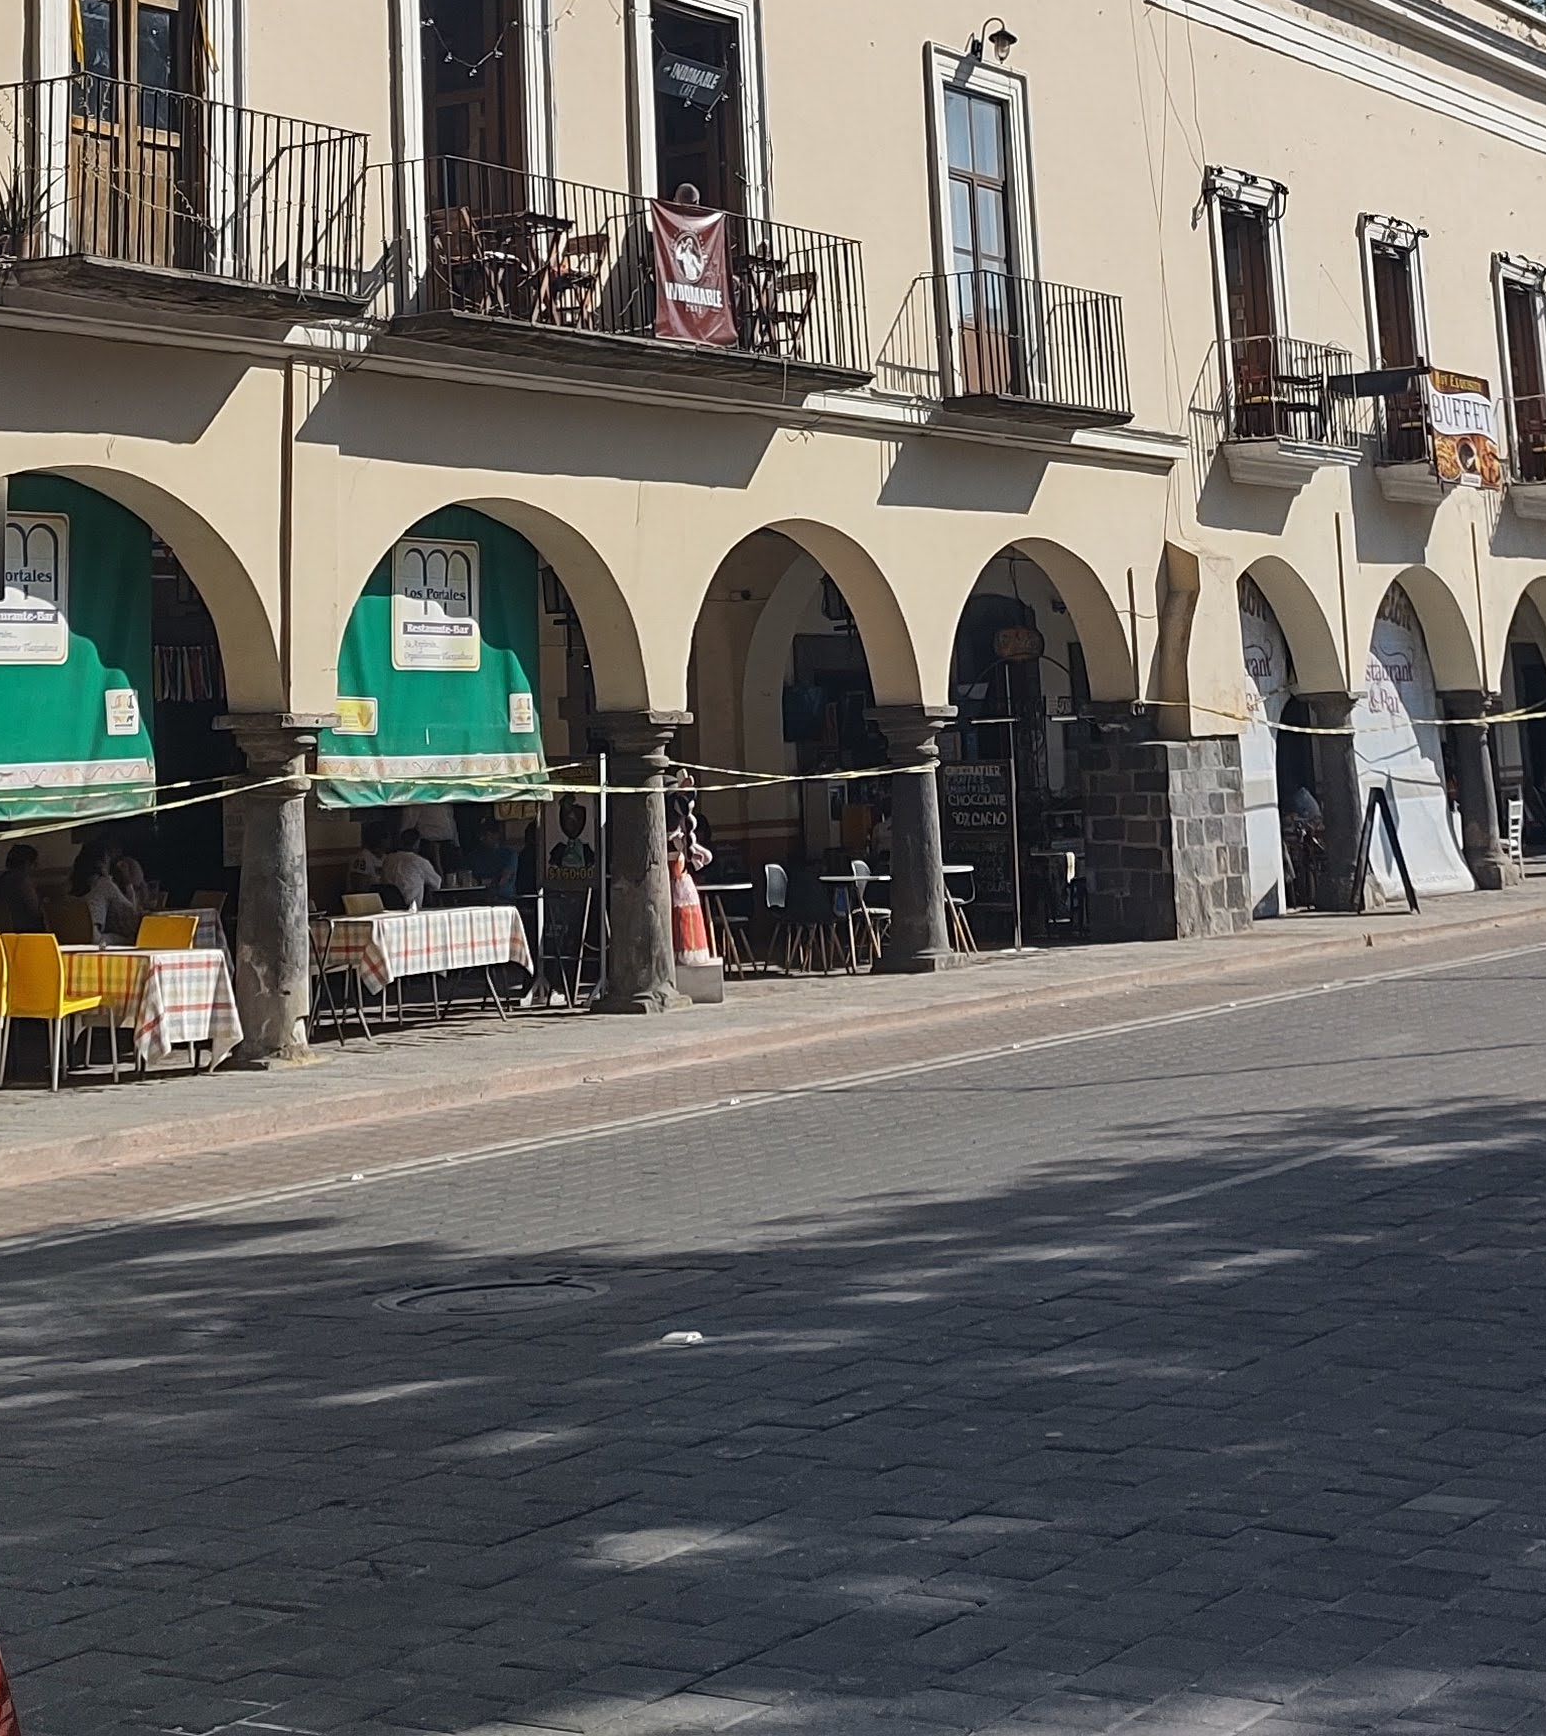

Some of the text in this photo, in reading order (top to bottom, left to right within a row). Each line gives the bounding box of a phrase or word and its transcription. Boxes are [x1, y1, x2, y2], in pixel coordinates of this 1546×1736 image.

[670, 62, 721, 90] INDOMABLE
[1432, 394, 1491, 433] BUFFET
[5, 569, 53, 583] ortales
[404, 586, 467, 601] Los Portales
[947, 794, 1007, 807] CHOCOLATE
